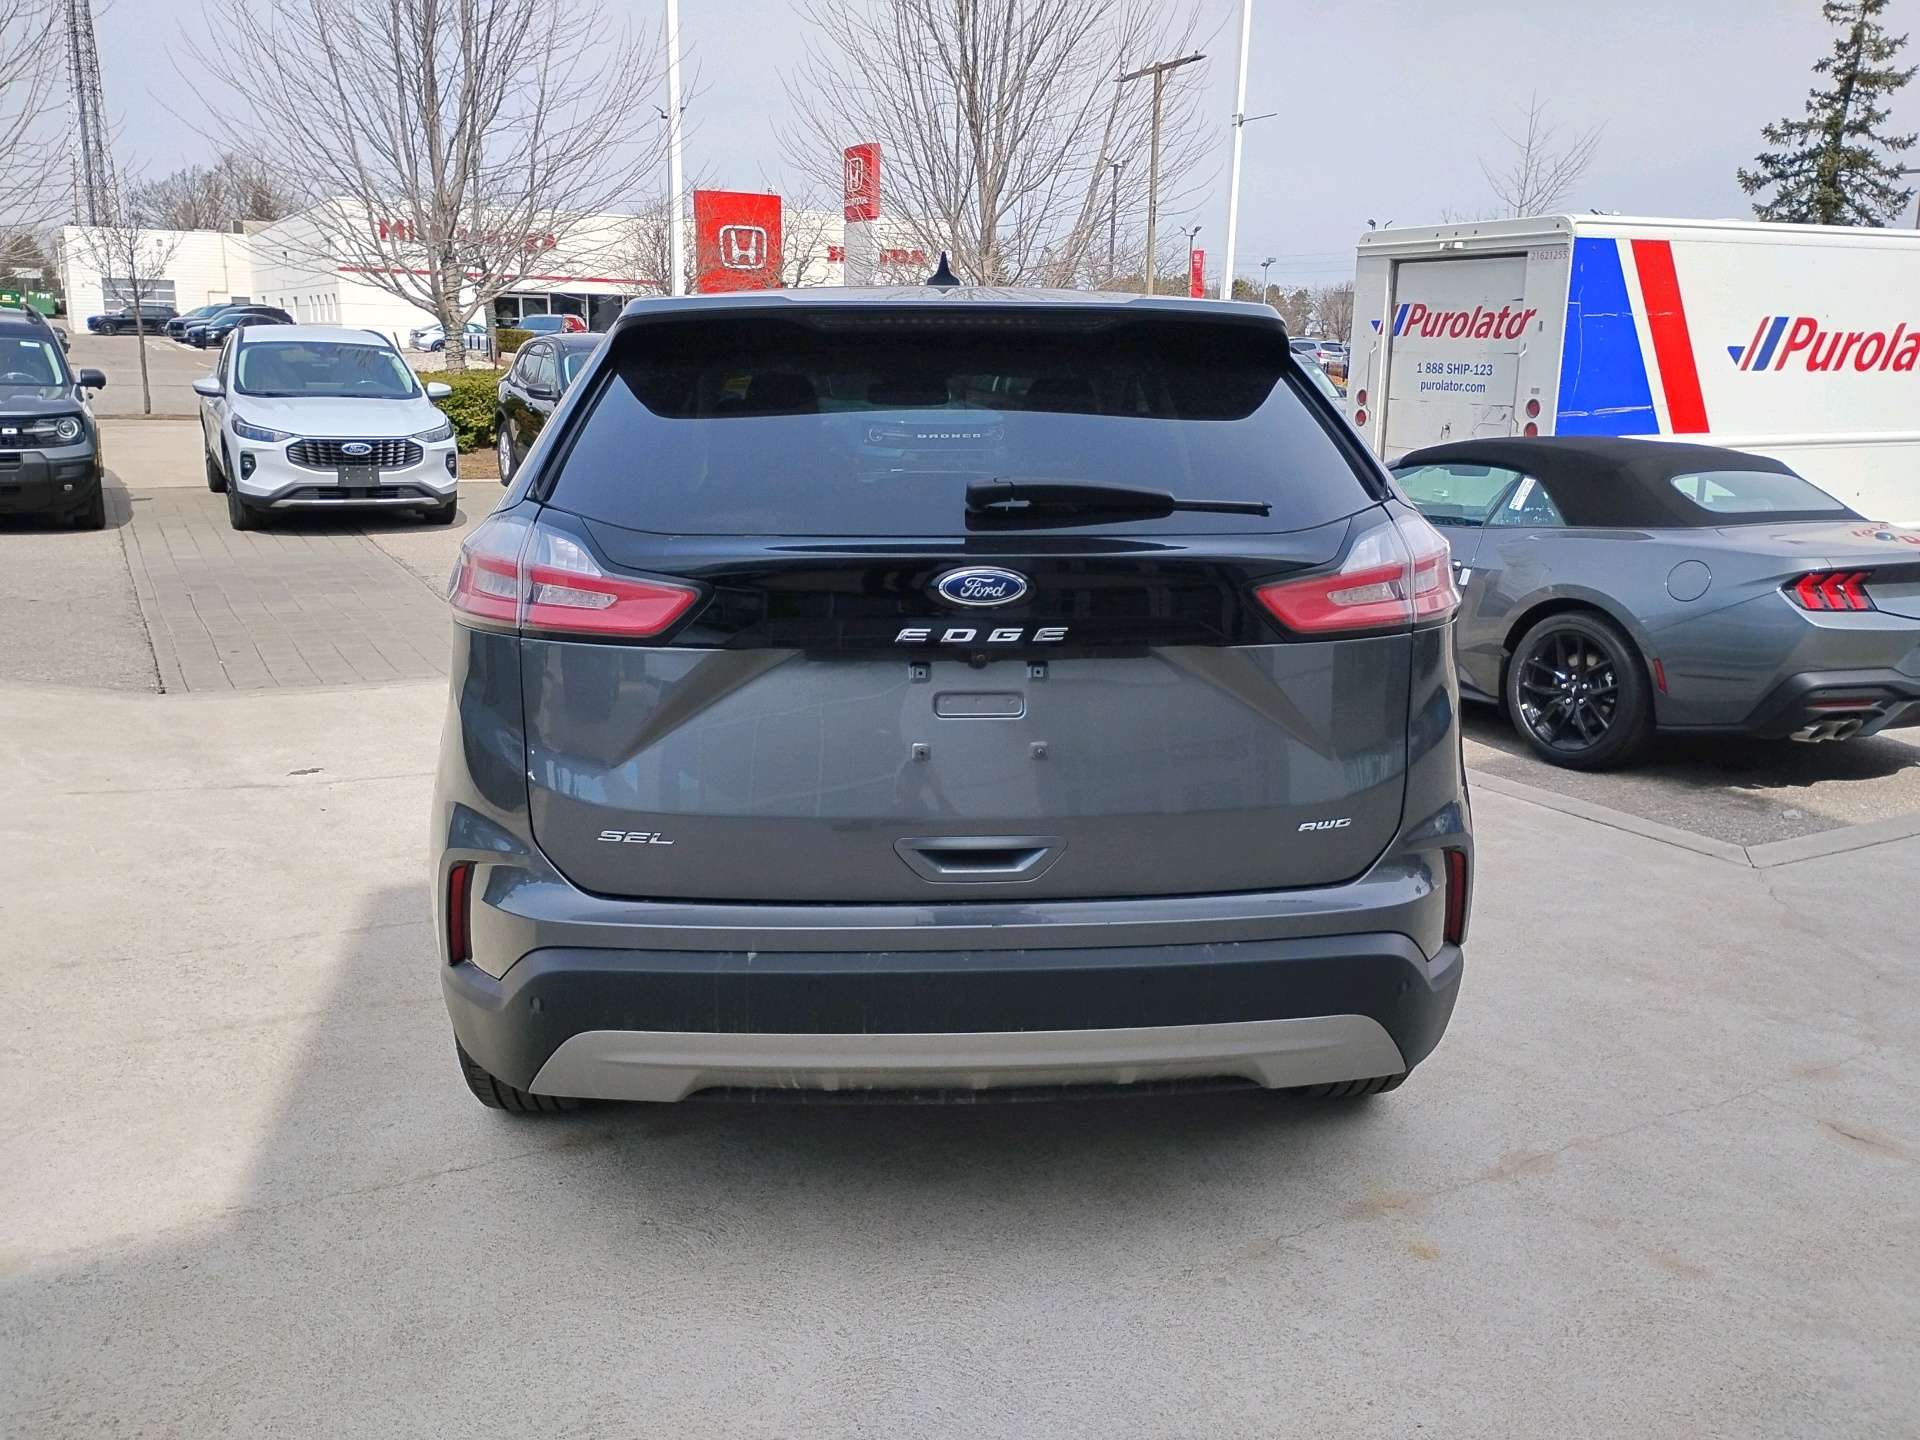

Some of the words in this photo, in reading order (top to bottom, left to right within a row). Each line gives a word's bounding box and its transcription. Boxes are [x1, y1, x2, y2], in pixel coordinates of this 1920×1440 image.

[1403, 304, 1537, 339] Purolator
[1774, 316, 1920, 371] Purola
[1416, 362, 1423, 373] 1
[1424, 363, 1444, 374] 888
[1446, 363, 1493, 376] SHIP-123
[1420, 380, 1486, 393] purolator.com
[960, 577, 1006, 598] Ford
[894, 627, 1069, 643] EDGE
[1298, 818, 1352, 832] AWD
[597, 830, 675, 845] SEL
